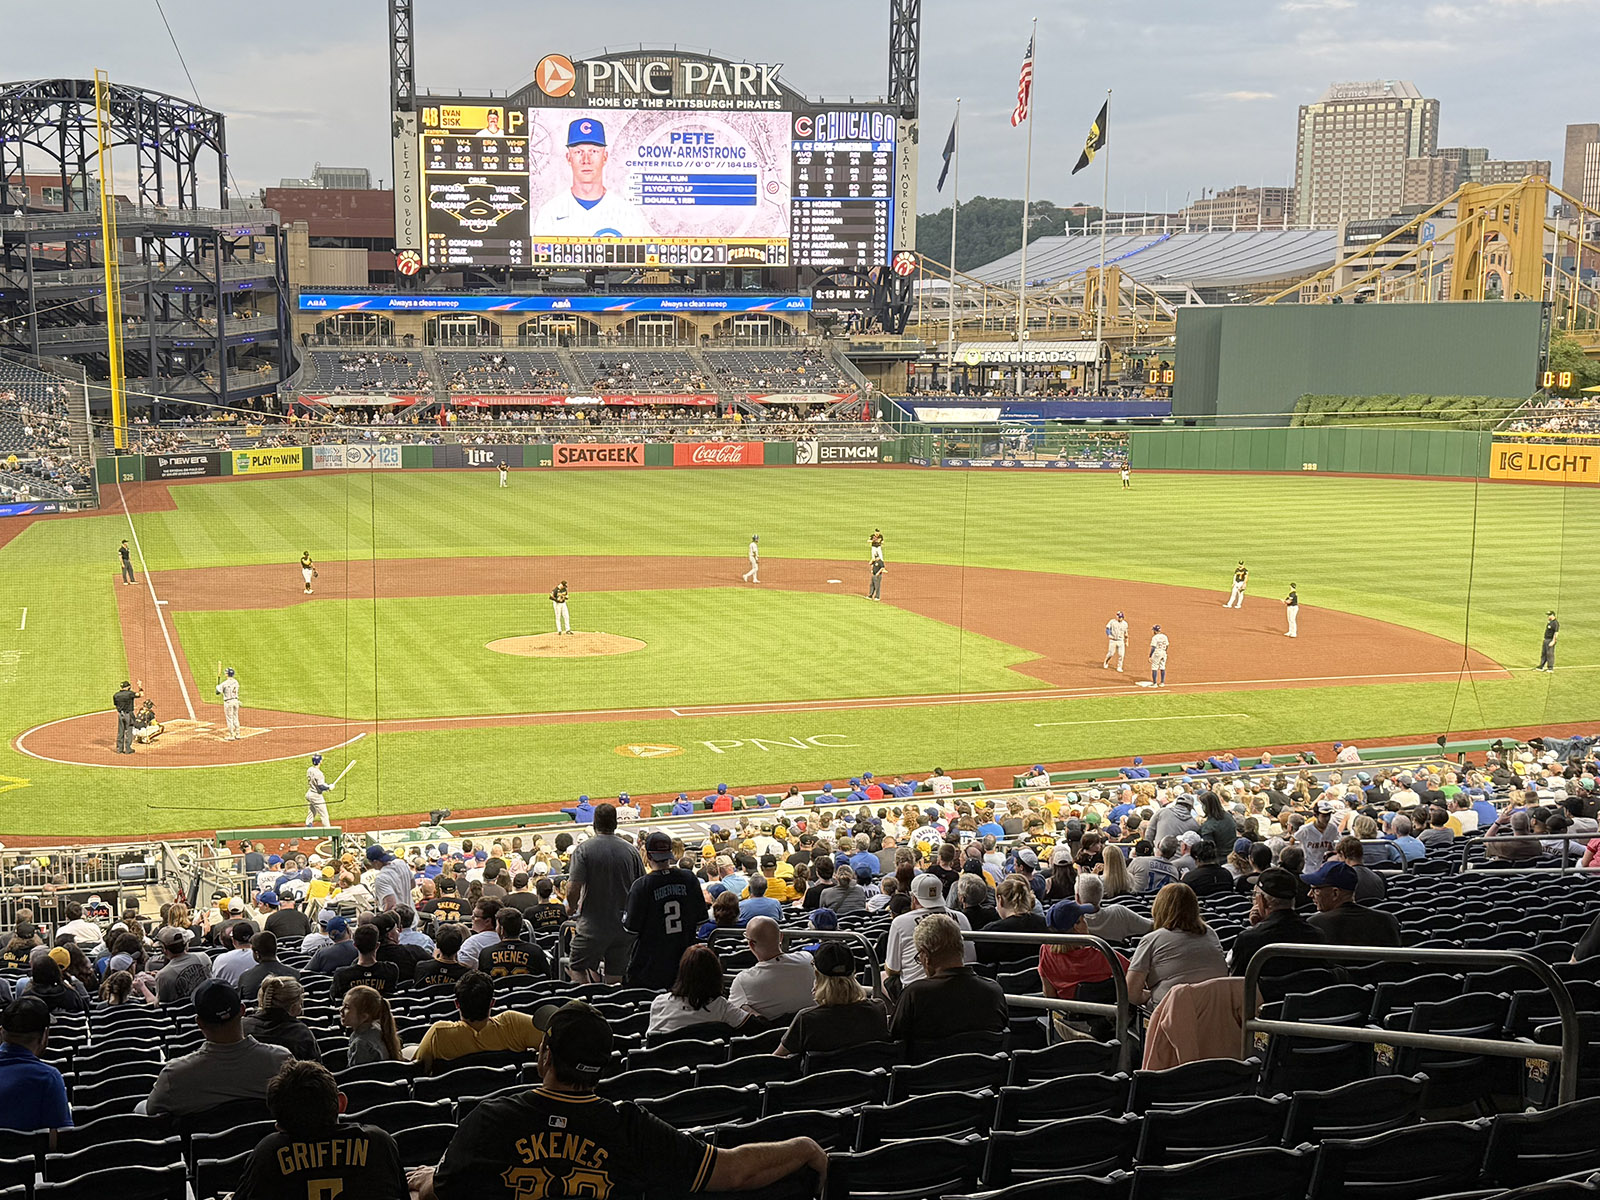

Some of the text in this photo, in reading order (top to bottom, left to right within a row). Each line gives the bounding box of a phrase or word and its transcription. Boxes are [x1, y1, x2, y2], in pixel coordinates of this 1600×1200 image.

[582, 60, 784, 97] PNC PARK
[588, 98, 782, 111] HOME OF THE PITTSBURGH PIRATES
[422, 107, 439, 127] 48
[442, 109, 461, 117] EVAN
[442, 118, 461, 126] SISK
[508, 111, 524, 134] P
[795, 116, 813, 137] C
[815, 111, 895, 142] CHICAGO
[670, 132, 714, 144] PETE
[638, 145, 746, 159] CROW-ARMSTRONG
[902, 146, 910, 170] EAT
[403, 142, 411, 179] LETZ
[625, 160, 659, 168] CENTER
[660, 160, 683, 168] FIELD
[743, 161, 758, 169] LBS
[644, 175, 689, 183] WALK, RUN
[900, 173, 911, 197] MOR
[403, 185, 411, 203] GO
[404, 208, 412, 246] BUCS
[811, 225, 830, 233] HAPP
[900, 201, 909, 248] CHIKIN
[554, 244, 562, 253] 2
[566, 244, 571, 253] 1
[575, 244, 581, 253] 0
[588, 244, 593, 253] 1
[596, 244, 603, 253] 0
[648, 244, 657, 253] 4
[670, 244, 677, 254] 0
[680, 244, 687, 254] 5
[727, 246, 766, 262] PIRATES
[810, 249, 829, 257] KELLY
[554, 254, 562, 264] 0
[564, 254, 572, 264] 0
[574, 254, 582, 264] 3
[587, 254, 592, 264] 1
[596, 254, 603, 264] 0
[649, 255, 655, 263] 4
[670, 254, 677, 264] 0
[680, 254, 687, 264] 2
[815, 289, 835, 299] 8:15
[836, 290, 850, 299] PM
[388, 299, 412, 308] Always
[418, 299, 437, 307] clean
[437, 301, 459, 309] sweep
[660, 299, 683, 308] Always
[688, 299, 706, 308] clean
[706, 301, 727, 309] sweep
[984, 351, 1077, 363] FAT HEAD'S
[1543, 371, 1572, 388] 0:18
[252, 454, 272, 467] PLAY
[281, 453, 300, 465] WIN!
[377, 447, 399, 463] 125
[467, 449, 494, 467] Lite
[558, 446, 639, 464] SEATGEEK
[692, 445, 744, 463] Coca-Cola
[820, 446, 878, 458] BETMGM
[1528, 454, 1592, 472] LIGHT
[122, 473, 134, 481] 325
[694, 733, 861, 754] PNC
[534, 909, 562, 922] SKENES
[664, 900, 682, 935] 2
[491, 951, 530, 966] SKENES
[276, 1138, 369, 1176] GRIFFIN
[515, 1131, 609, 1169] SKENES
